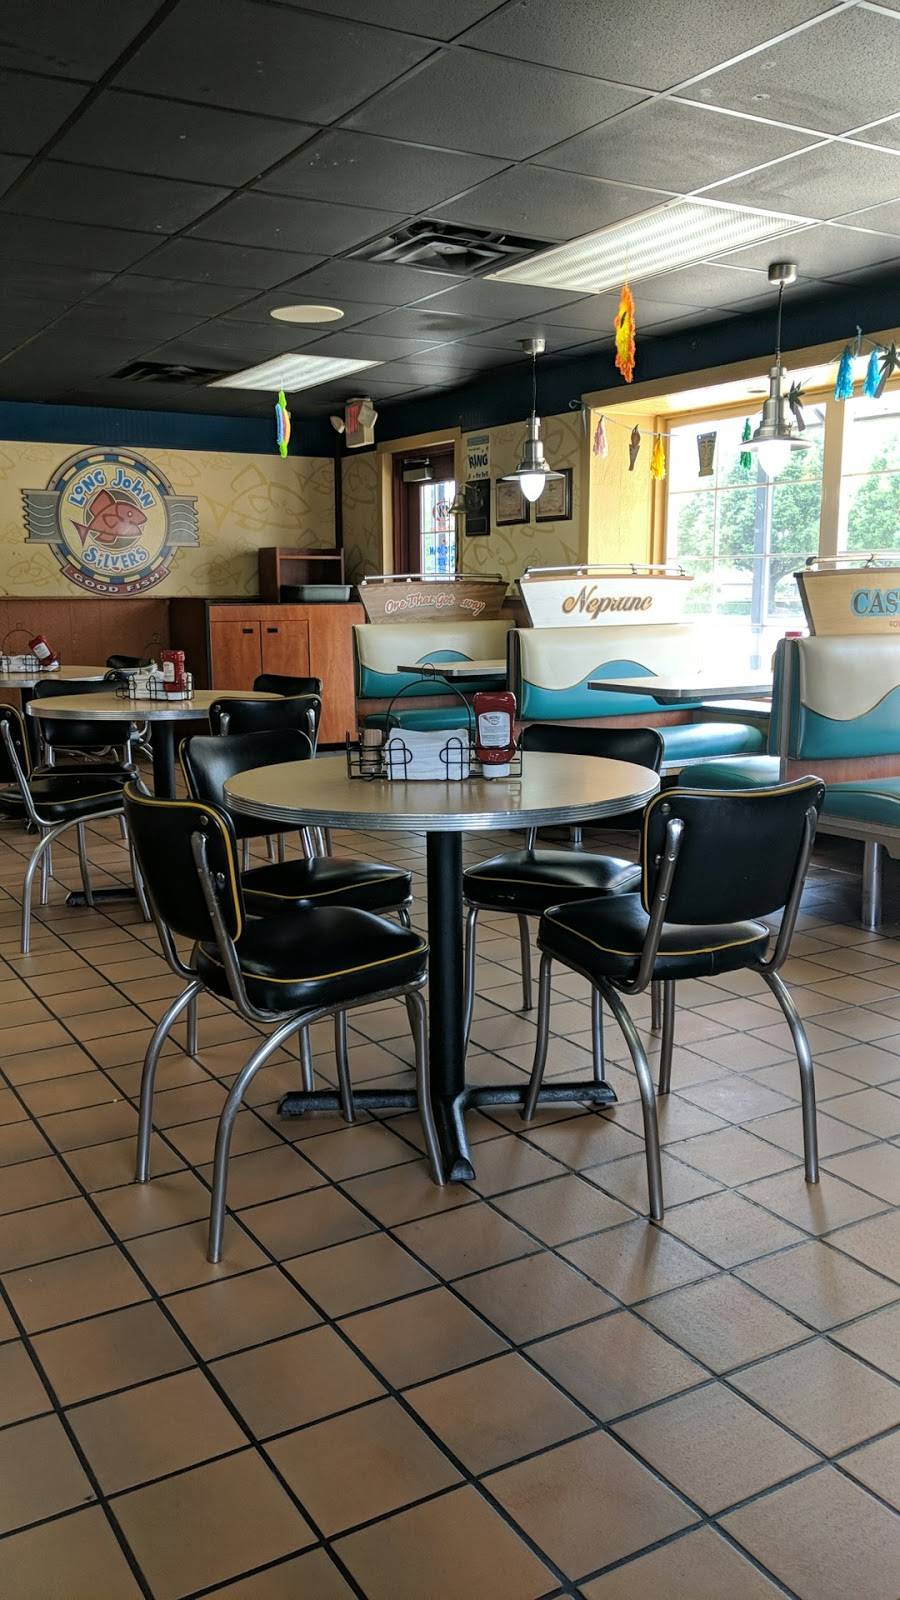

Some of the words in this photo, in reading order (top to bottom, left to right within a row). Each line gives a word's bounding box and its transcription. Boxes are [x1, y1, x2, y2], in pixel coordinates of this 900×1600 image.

[468, 454, 488, 469] RING
[74, 573, 119, 592] GOOD
[126, 573, 160, 592] FISH
[460, 598, 486, 617] way
[562, 585, 653, 620] Neptune
